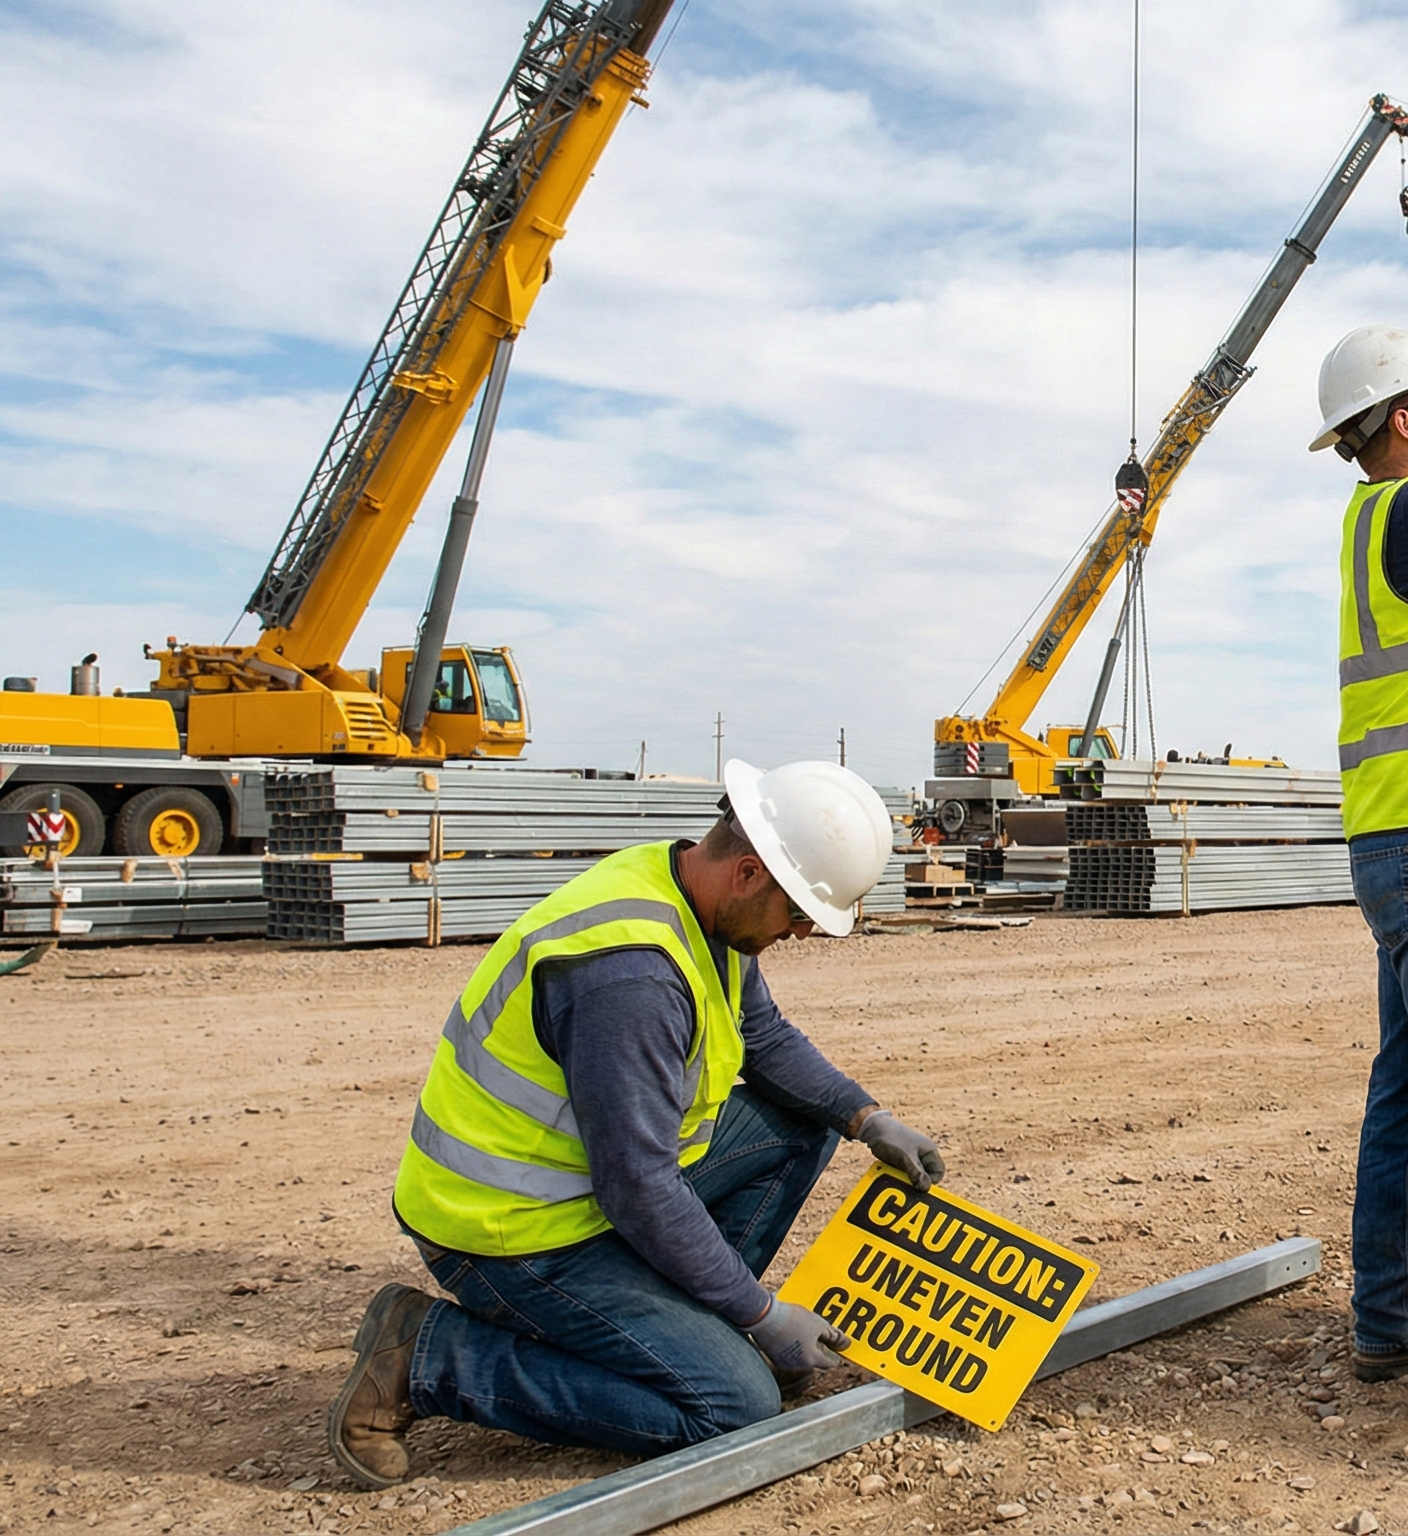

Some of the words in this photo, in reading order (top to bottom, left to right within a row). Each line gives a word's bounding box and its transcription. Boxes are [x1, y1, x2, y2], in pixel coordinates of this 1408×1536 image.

[847, 1243, 1016, 1350] UNEVEN
[867, 1187, 1066, 1308] CAUTION:
[812, 1286, 988, 1394] GROUND
